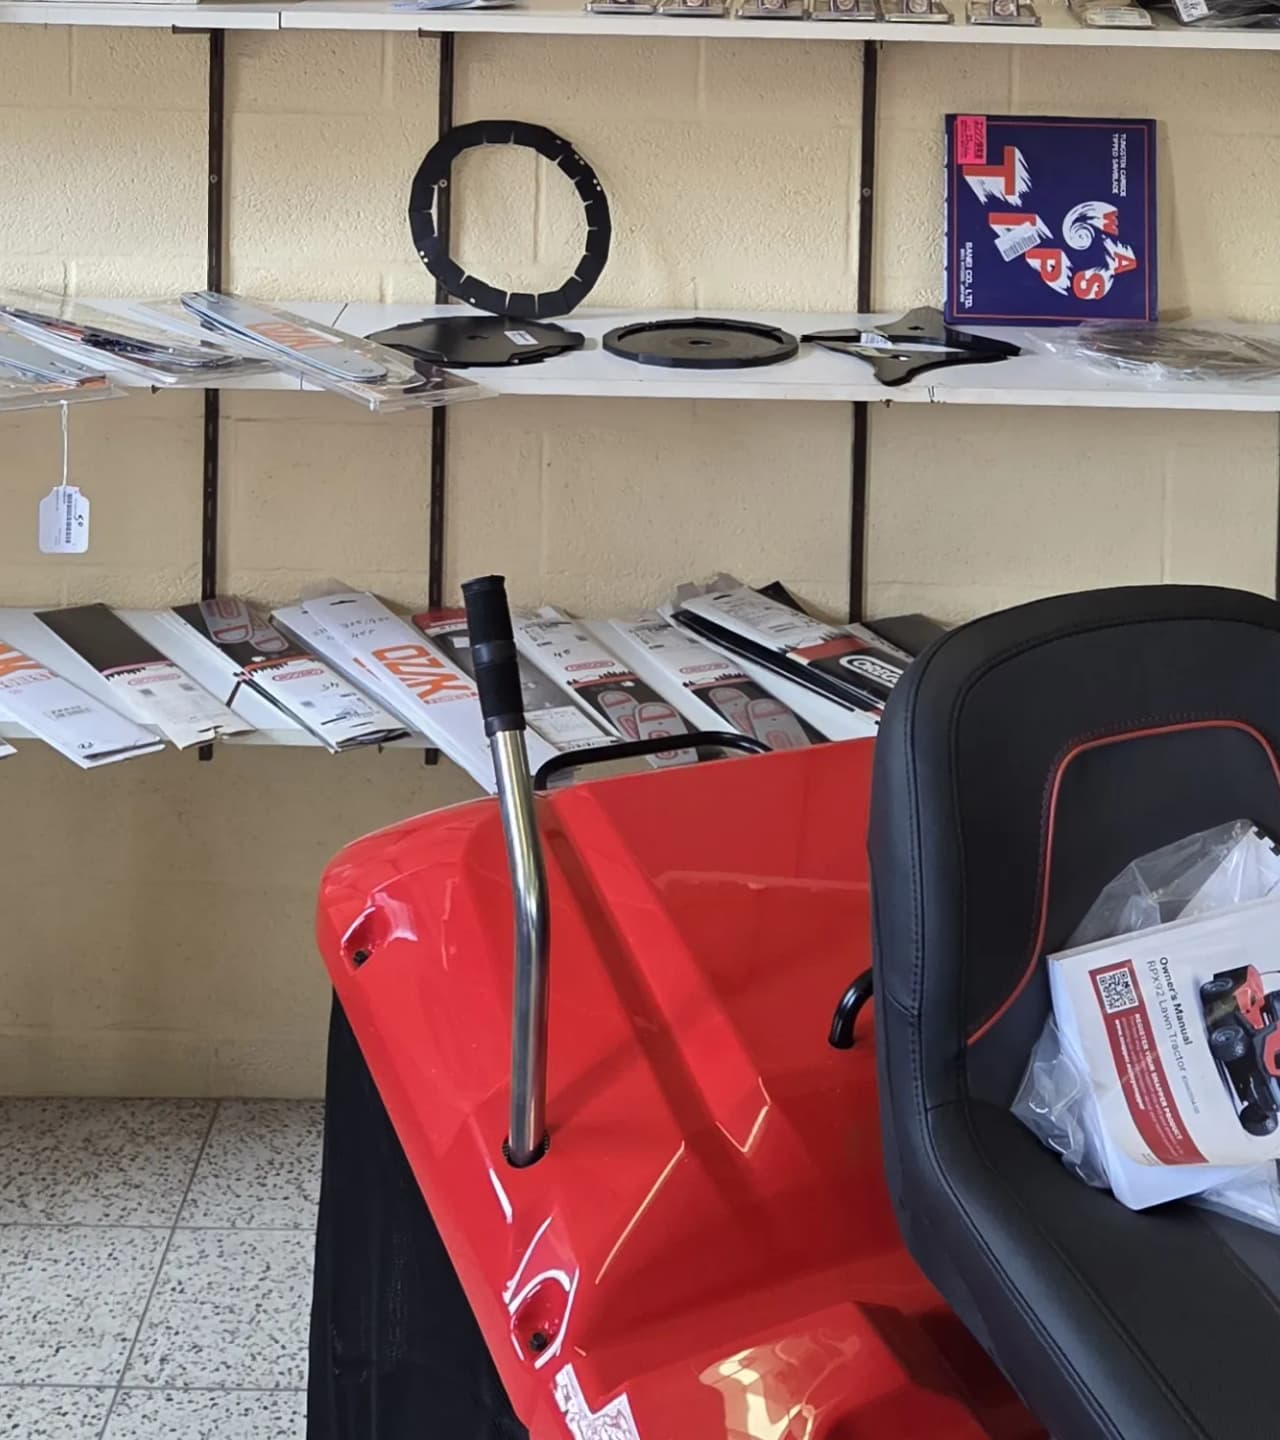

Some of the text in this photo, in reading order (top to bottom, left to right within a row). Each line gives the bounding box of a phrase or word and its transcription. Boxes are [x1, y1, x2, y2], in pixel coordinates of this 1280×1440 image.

[1120, 133, 1128, 168] TUNGSTEN
[852, 659, 906, 685] OREG
[1147, 960, 1187, 1072] RPX92 Lawn Tractor
[1159, 956, 1193, 1046] Owner's Manual
[1135, 1013, 1183, 1140] REGISTER YOUR SNAPPER PRODUCT
